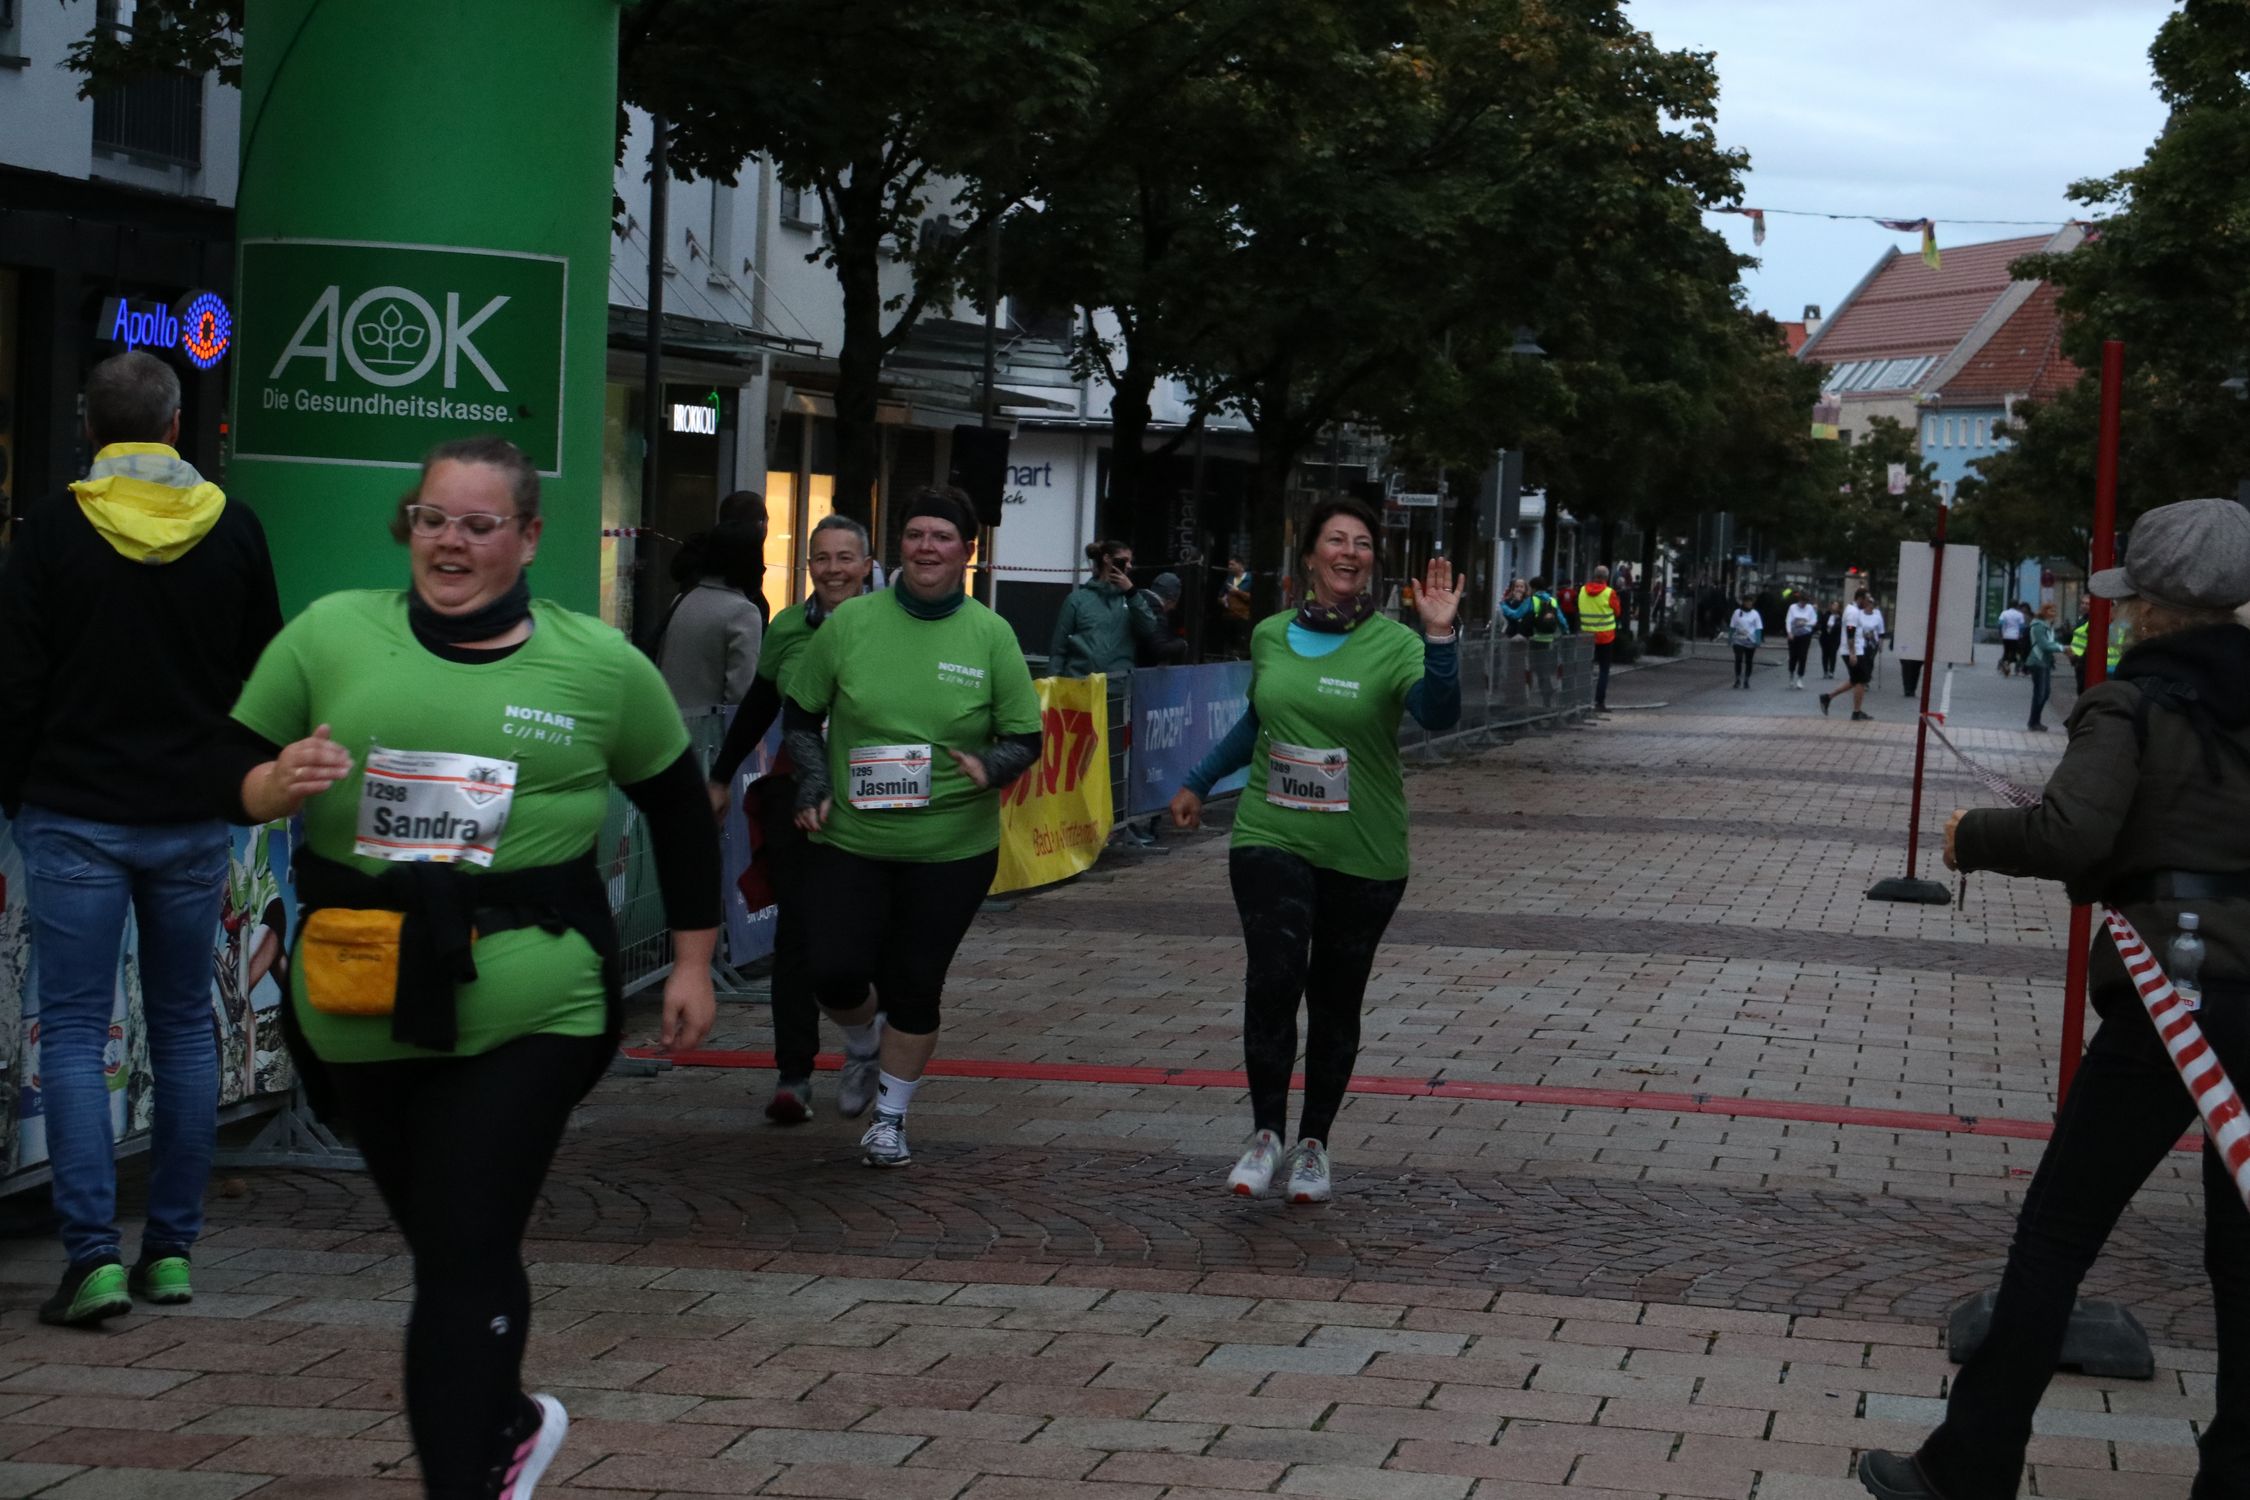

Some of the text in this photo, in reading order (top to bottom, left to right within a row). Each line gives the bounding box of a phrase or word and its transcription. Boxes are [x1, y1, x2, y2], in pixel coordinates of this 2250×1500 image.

[112, 296, 179, 353] Apollo
[268, 284, 513, 393] AOK
[263, 387, 514, 423] Die Gesundheitskasse.
[938, 661, 985, 679] NOTARE
[504, 704, 577, 731] NOTARE
[851, 766, 873, 778] 1295
[366, 781, 408, 803] 1298
[856, 778, 919, 797] Jasmin
[1281, 777, 1326, 799] Viola
[373, 806, 481, 842] Sandra
